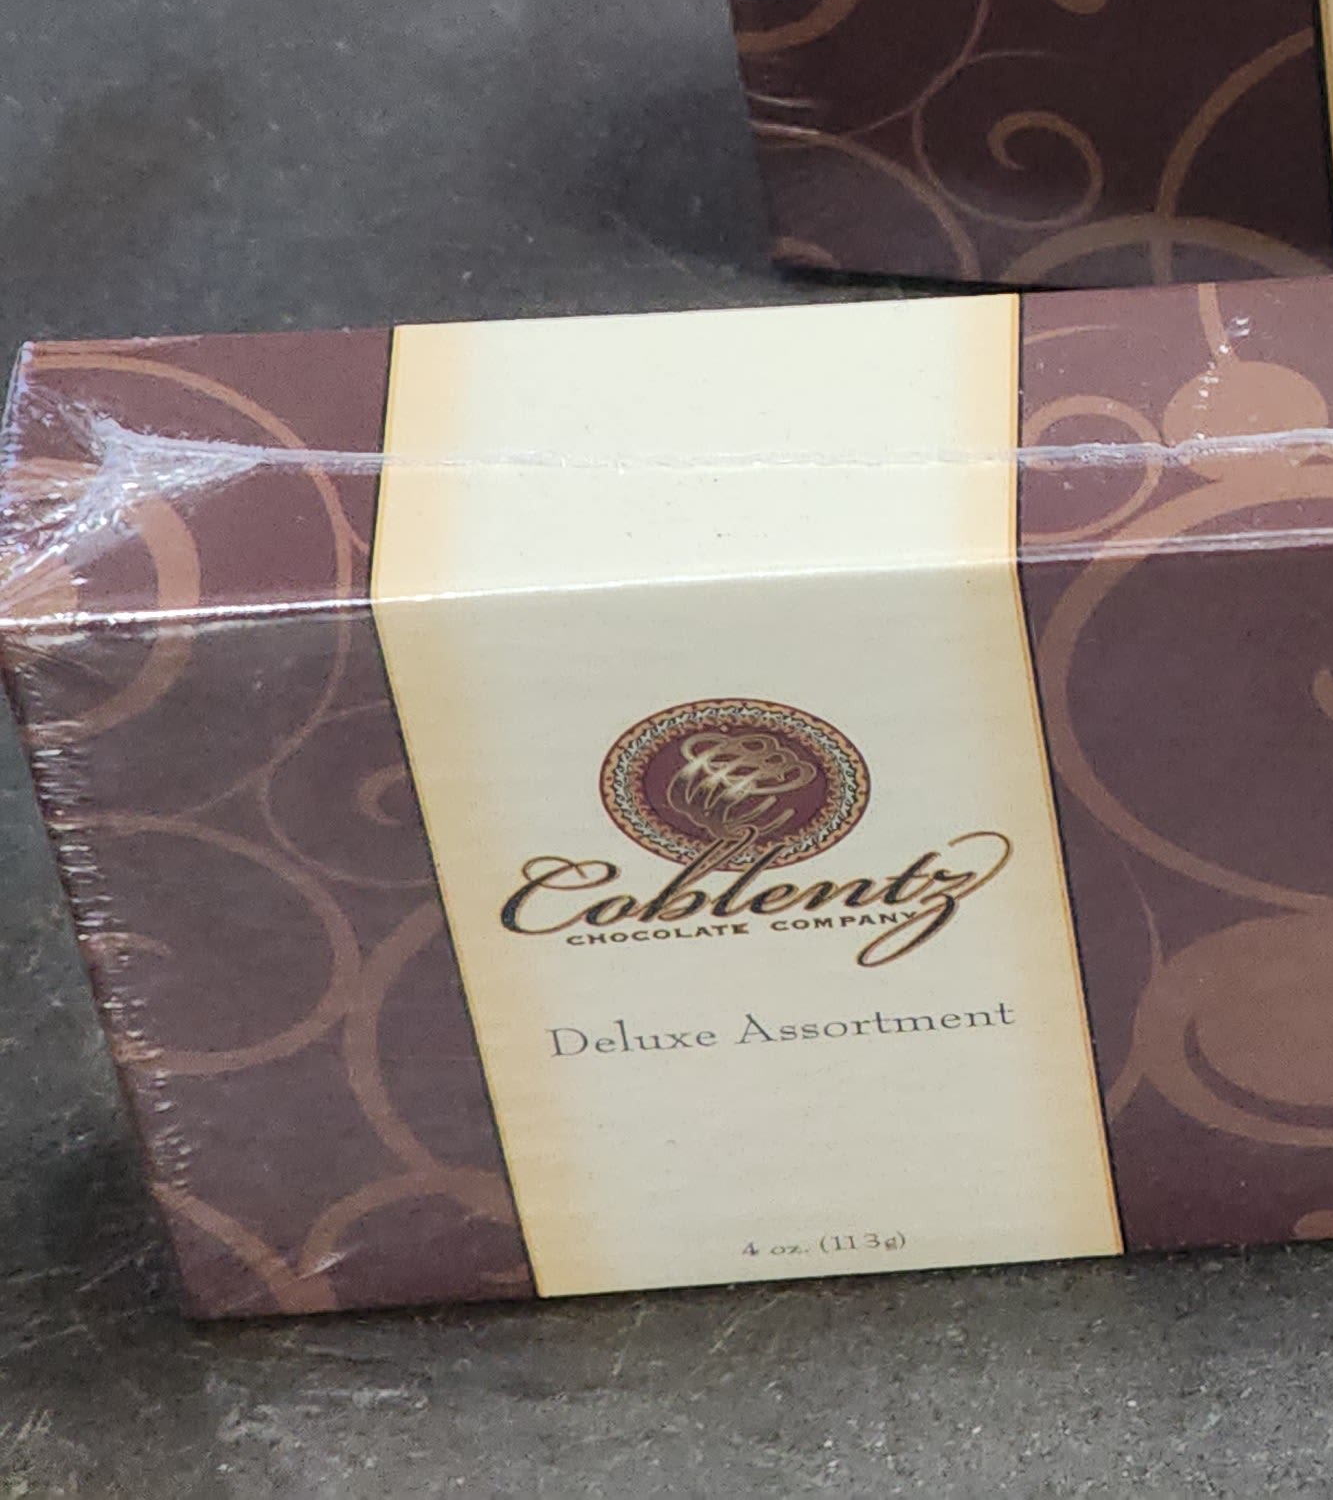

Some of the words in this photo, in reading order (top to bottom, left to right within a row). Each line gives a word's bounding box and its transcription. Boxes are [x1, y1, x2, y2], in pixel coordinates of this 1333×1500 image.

[501, 825, 1012, 968] Coblentz
[566, 922, 749, 947] CHOCOLATE
[770, 909, 920, 933] COMPANY
[545, 1019, 718, 1059] Deluxe
[734, 1001, 1016, 1045] Assortment
[741, 1240, 760, 1257] 4
[770, 1242, 808, 1257] oz.
[819, 1230, 906, 1255] (113g)
